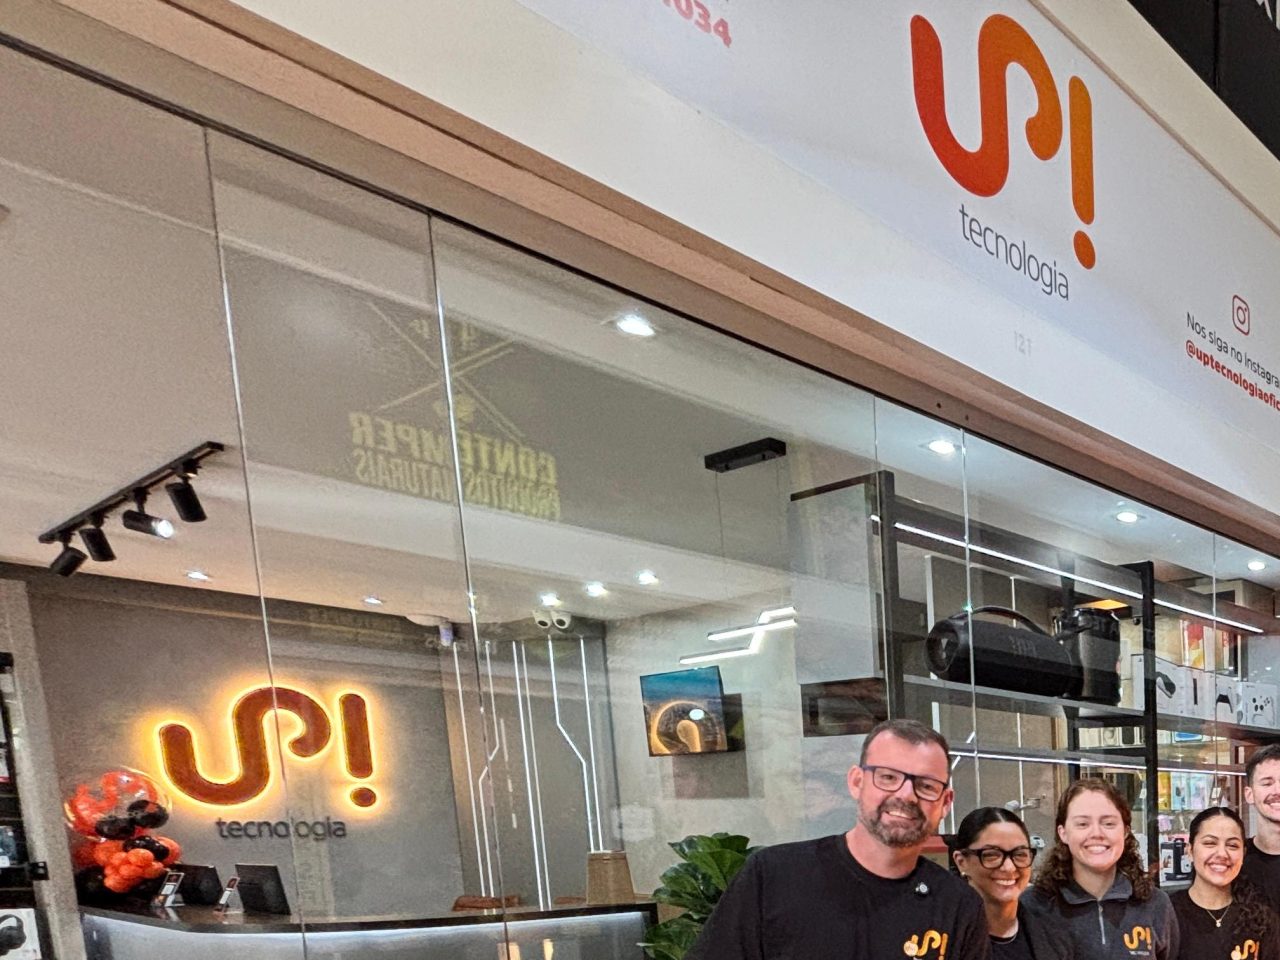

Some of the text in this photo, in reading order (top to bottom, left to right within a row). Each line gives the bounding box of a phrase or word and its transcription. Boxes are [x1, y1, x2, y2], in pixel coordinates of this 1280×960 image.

[663, 0, 732, 48] 034
[959, 203, 1069, 301] tecnologia
[1186, 311, 1207, 339] Nos
[1208, 330, 1229, 354] siga
[1230, 346, 1243, 363] no
